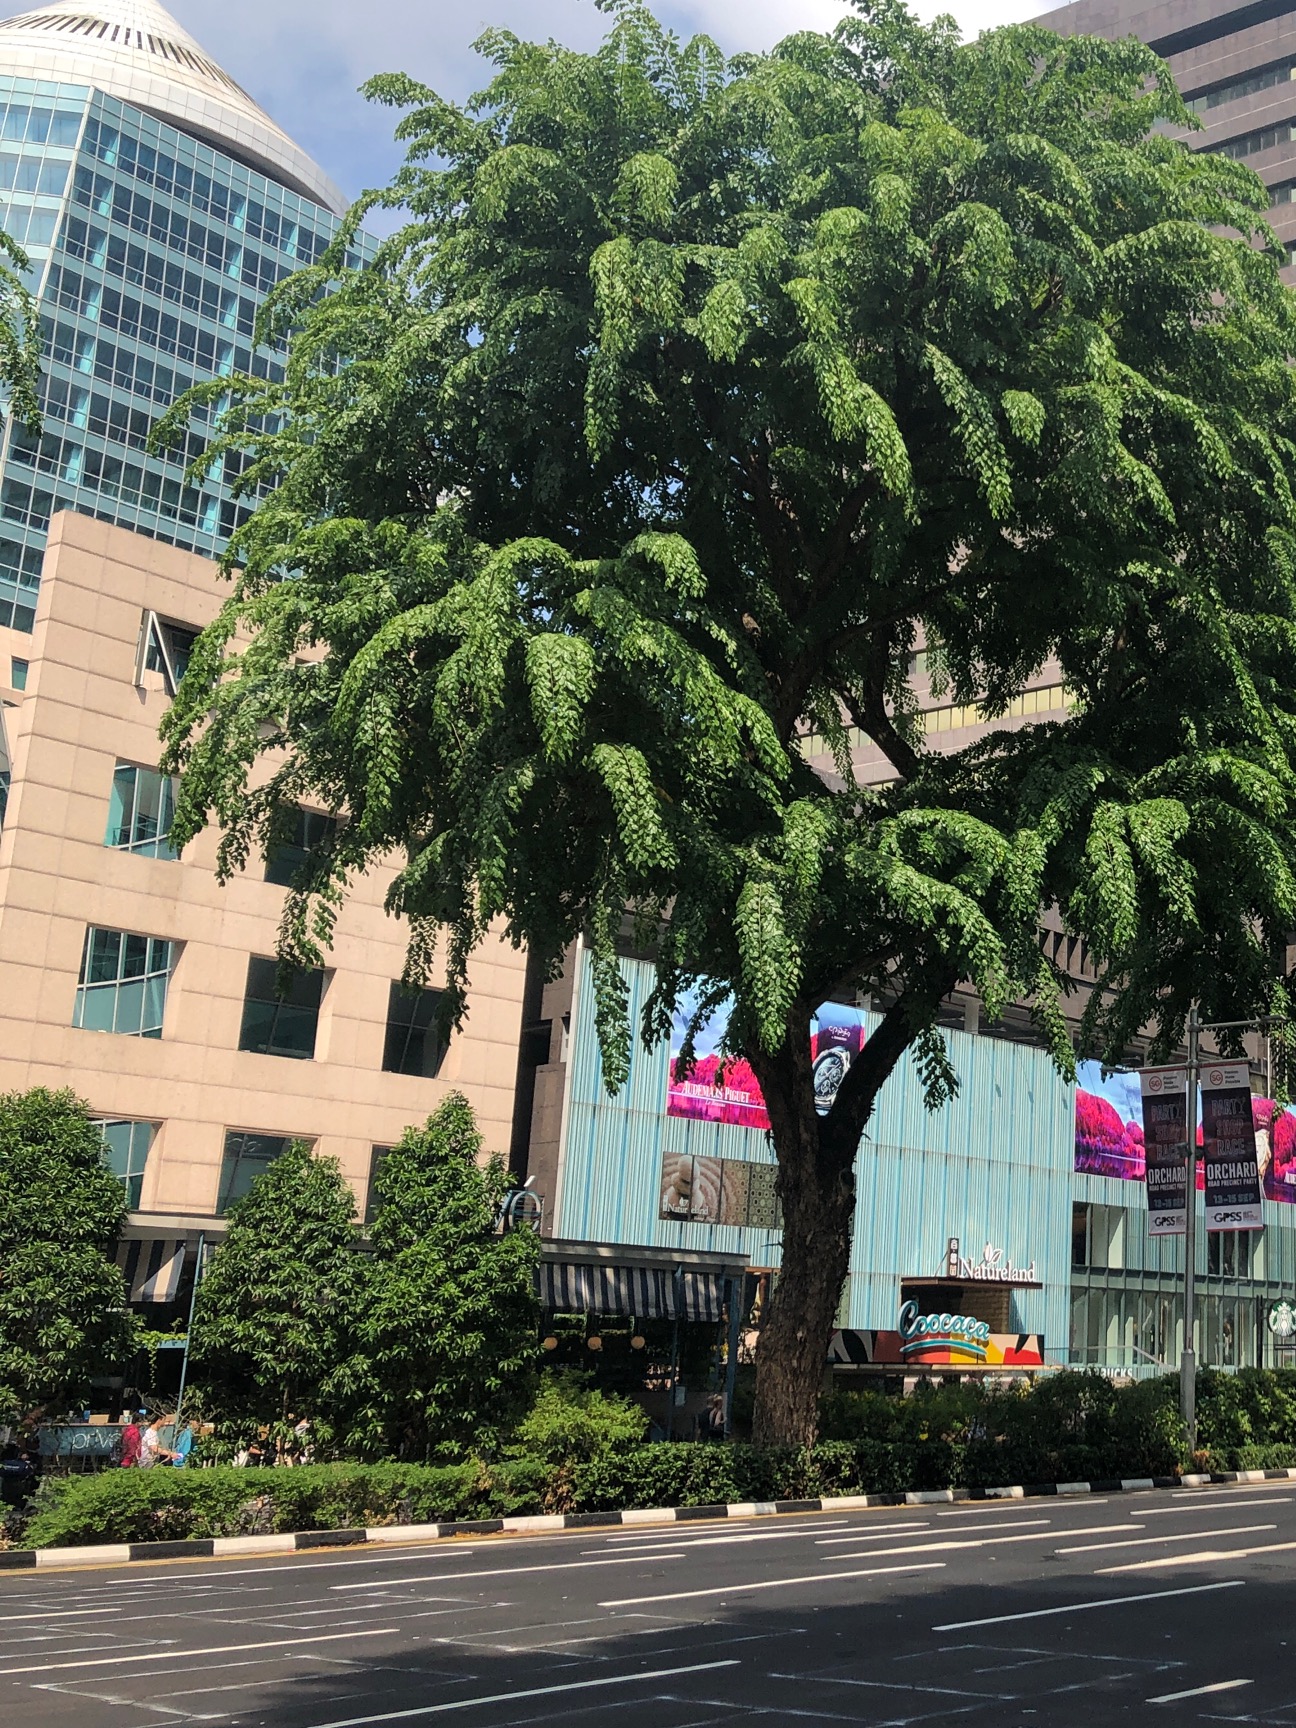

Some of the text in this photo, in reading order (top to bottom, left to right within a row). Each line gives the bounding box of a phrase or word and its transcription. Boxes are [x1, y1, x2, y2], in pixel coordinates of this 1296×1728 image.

[725, 1087, 750, 1103] PIGUET
[1217, 1139, 1245, 1156] RACE
[1148, 1167, 1186, 1184] ORCHARD
[1207, 1162, 1256, 1180] ORCHARD
[1238, 1194, 1254, 1202] SEP
[1155, 1216, 1175, 1227] GPSS
[1214, 1212, 1242, 1222] GPSS
[959, 1257, 1036, 1282] Natureland
